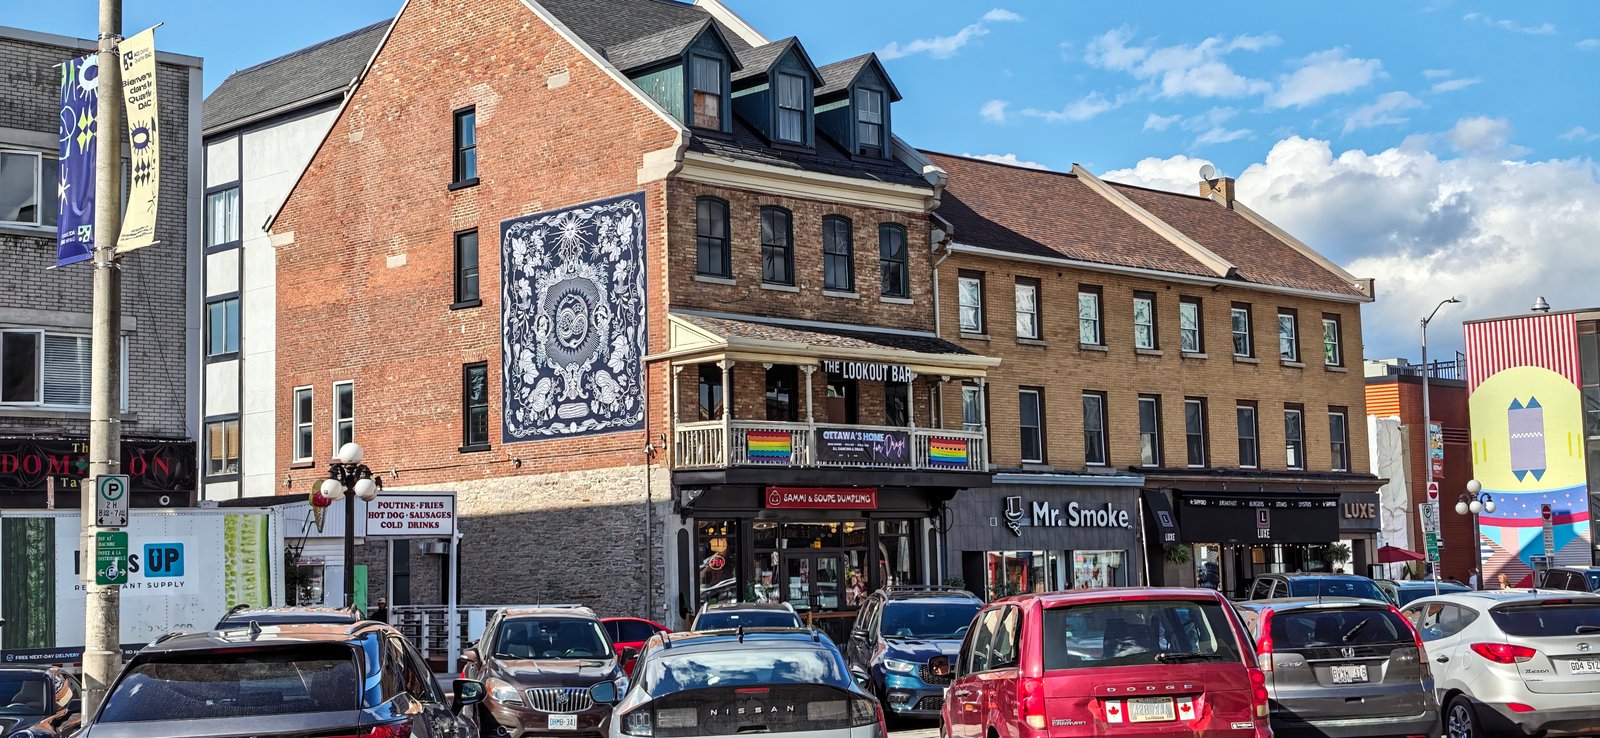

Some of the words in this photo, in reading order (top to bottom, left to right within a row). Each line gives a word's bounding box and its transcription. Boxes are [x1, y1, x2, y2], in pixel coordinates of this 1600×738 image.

[130, 84, 147, 94] dans
[138, 100, 152, 110] DAC
[824, 360, 840, 373] THE
[843, 361, 888, 381] LOOKOUT
[891, 365, 912, 382] BAR
[823, 430, 862, 440] OTTAWA'S
[863, 432, 884, 442] HOME
[72, 442, 88, 453] Th
[109, 484, 119, 495] P
[784, 494, 807, 502] SAMMI
[814, 494, 836, 503] SOUPE
[837, 494, 871, 503] DUMPLING
[1032, 501, 1062, 527] Mr.
[1068, 501, 1129, 527] Smoke
[1344, 502, 1376, 518] LUXE
[1261, 512, 1266, 521] L
[1165, 533, 1175, 541] LUXE
[1257, 529, 1270, 539] LUXE
[148, 548, 179, 572] UP
[710, 705, 794, 716] NISSAN
